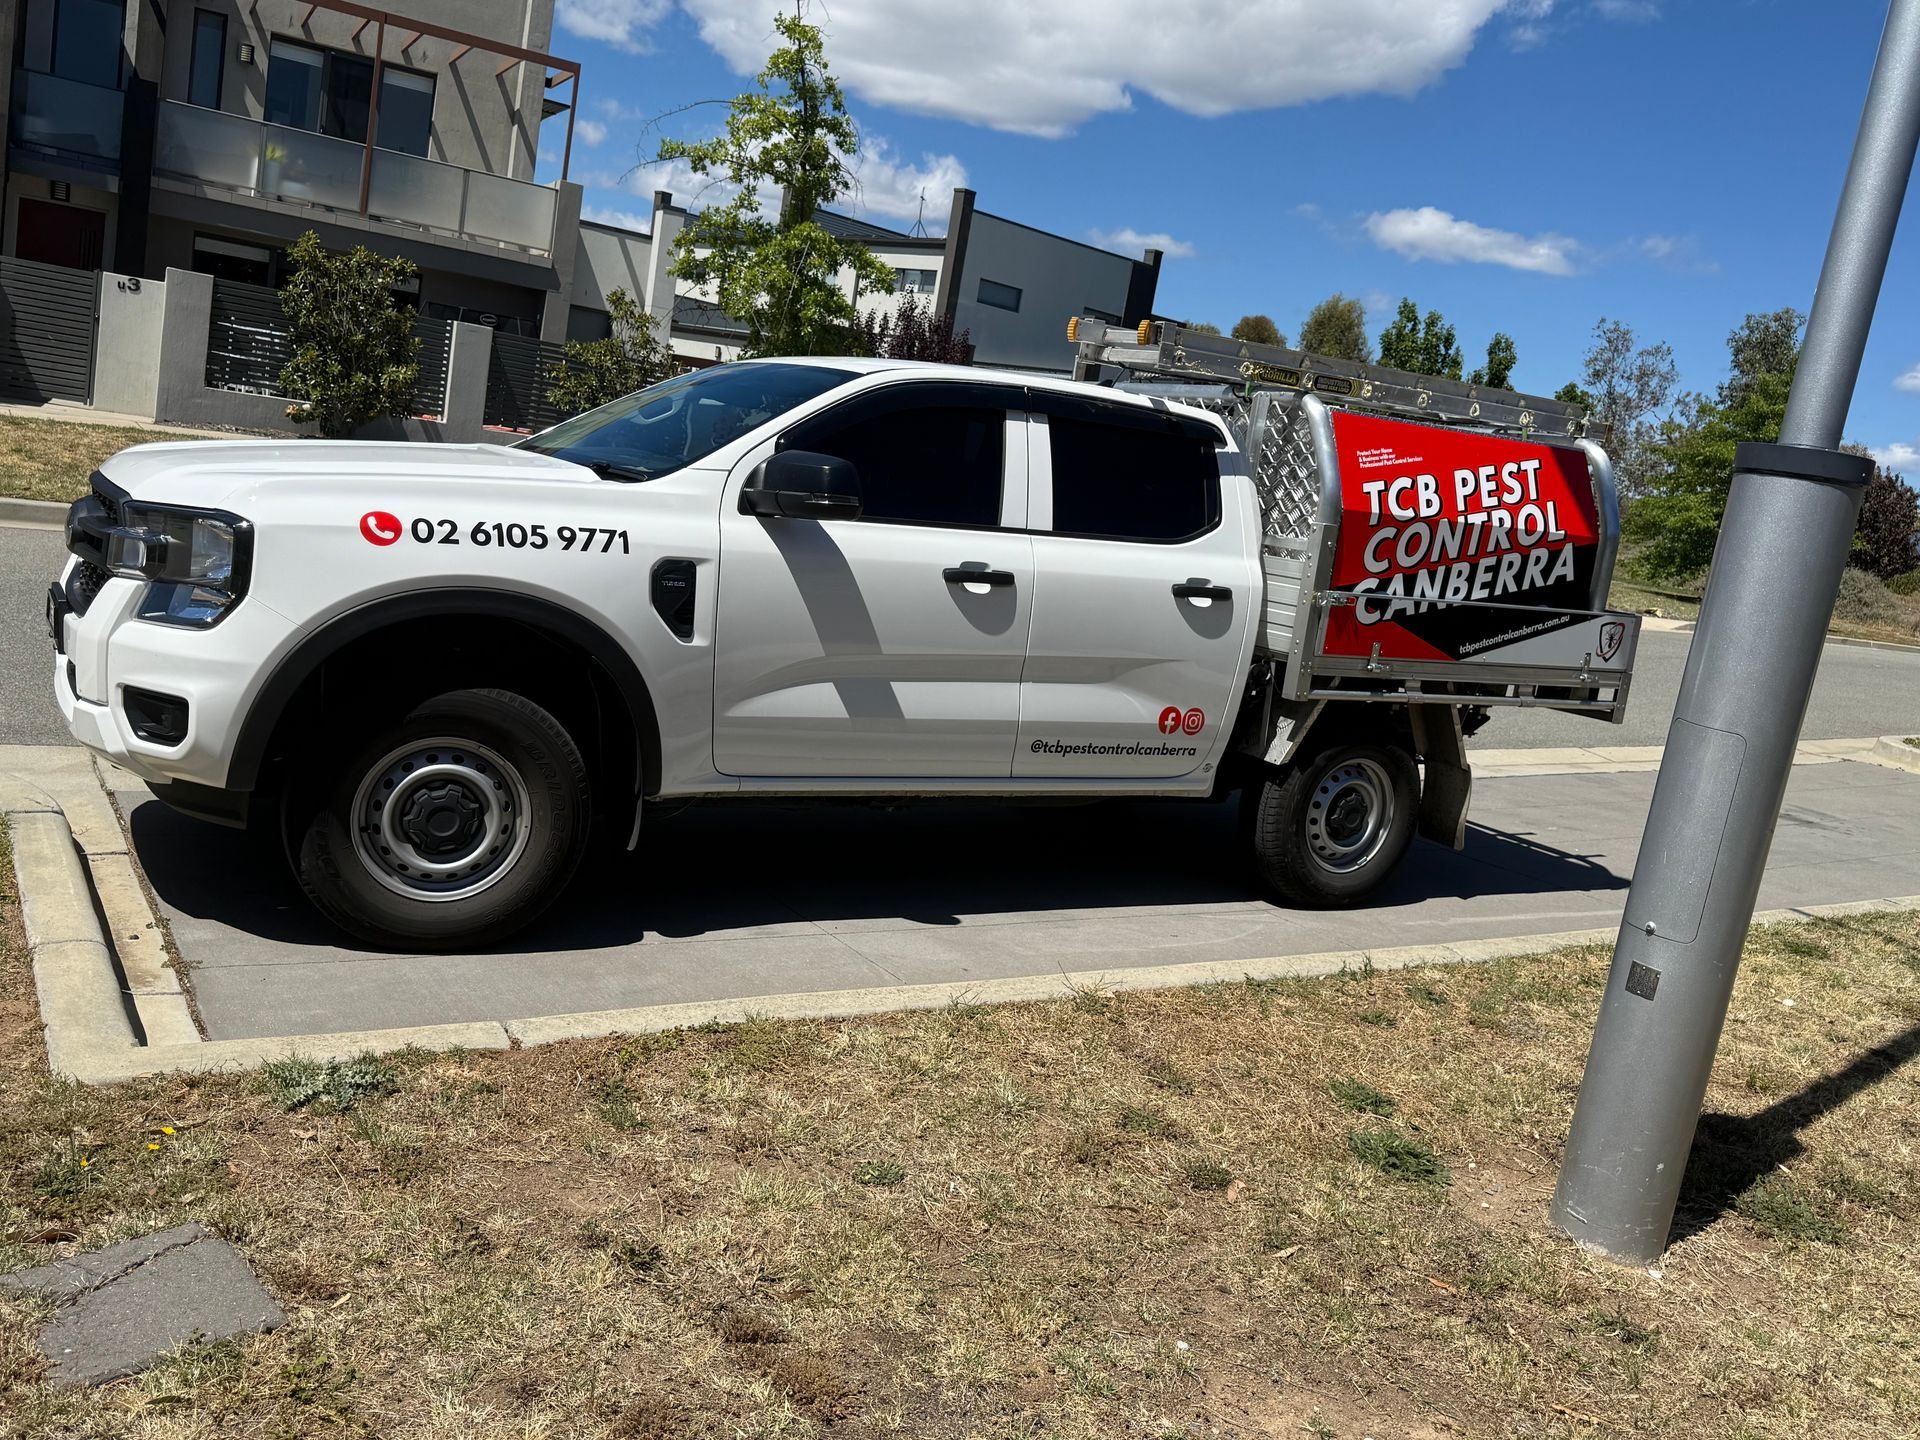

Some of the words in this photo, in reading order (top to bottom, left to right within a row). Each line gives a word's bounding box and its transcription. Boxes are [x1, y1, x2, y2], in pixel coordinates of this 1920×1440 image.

[1362, 473, 1441, 526] TCB
[1453, 459, 1541, 512] PEST
[410, 517, 460, 545] 02
[470, 521, 549, 550] 6105
[556, 525, 631, 555] 9771
[1363, 500, 1567, 574] CONTROL
[1351, 542, 1575, 625] CANBERRA
[1459, 614, 1571, 654] tcbpestcontrolcanberra.com.au
[1030, 739, 1197, 757] @tcbpestcontrolcanberra
